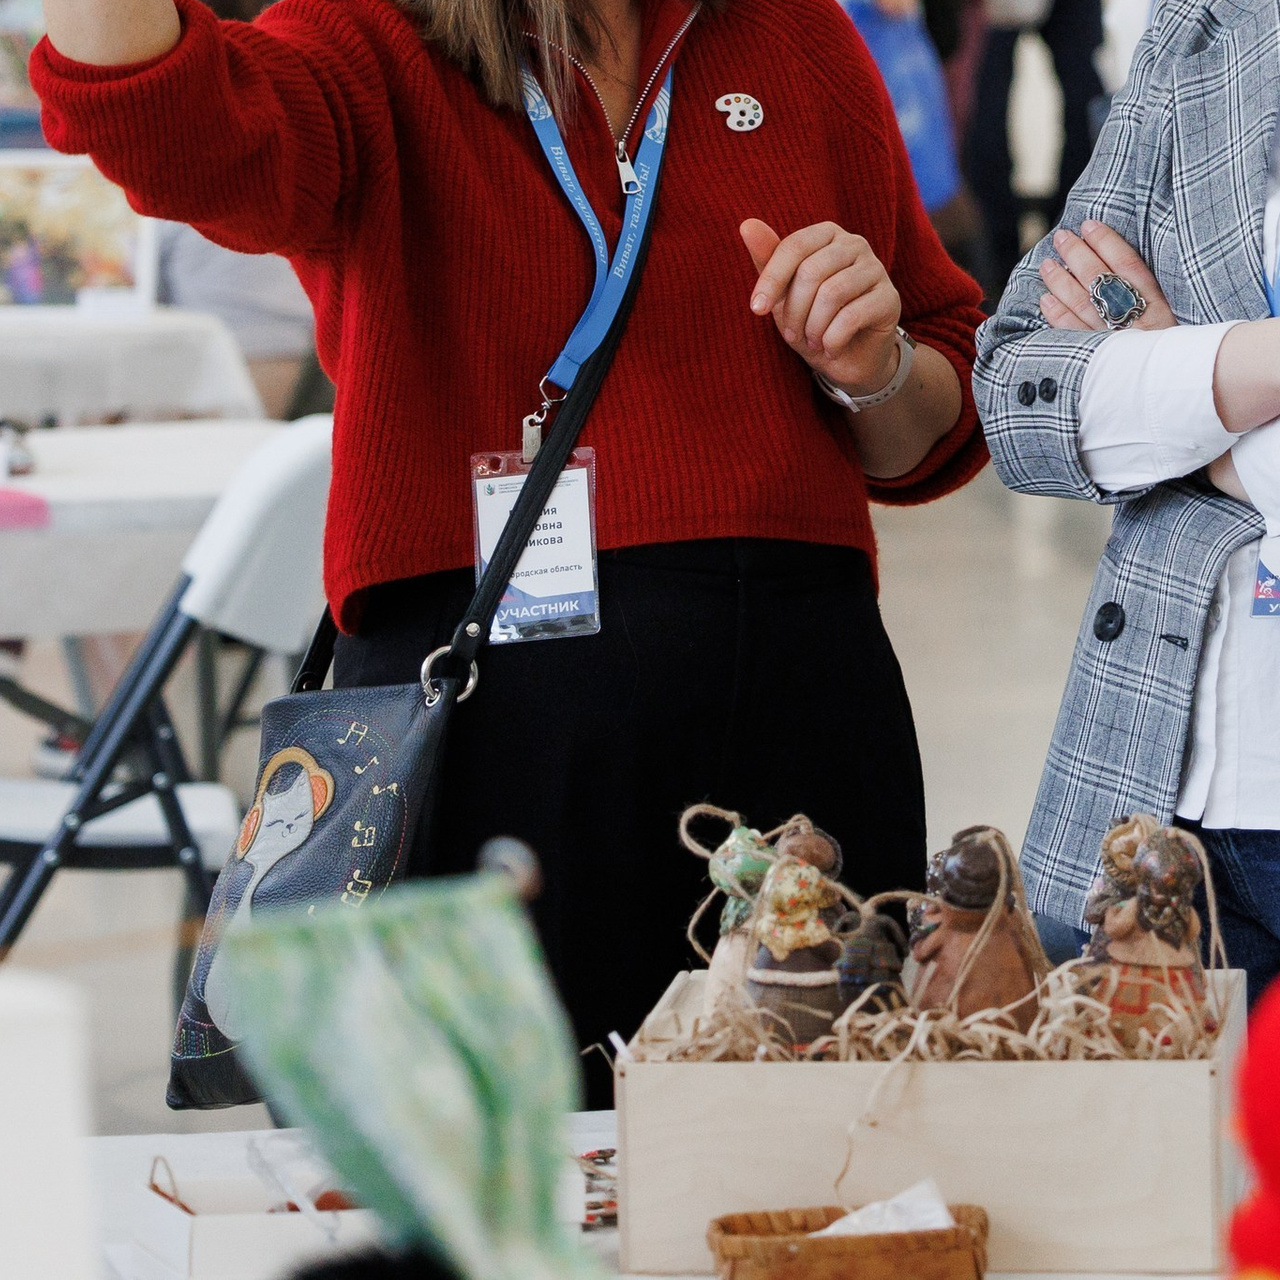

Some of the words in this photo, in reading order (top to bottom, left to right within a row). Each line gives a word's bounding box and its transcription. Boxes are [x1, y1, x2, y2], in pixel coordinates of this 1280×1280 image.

[550, 146, 576, 193] Виват,
[613, 232, 637, 279] Виват,
[511, 568, 548, 579] ородская
[550, 564, 583, 574] область
[499, 600, 580, 621] УЧАСТНИК
